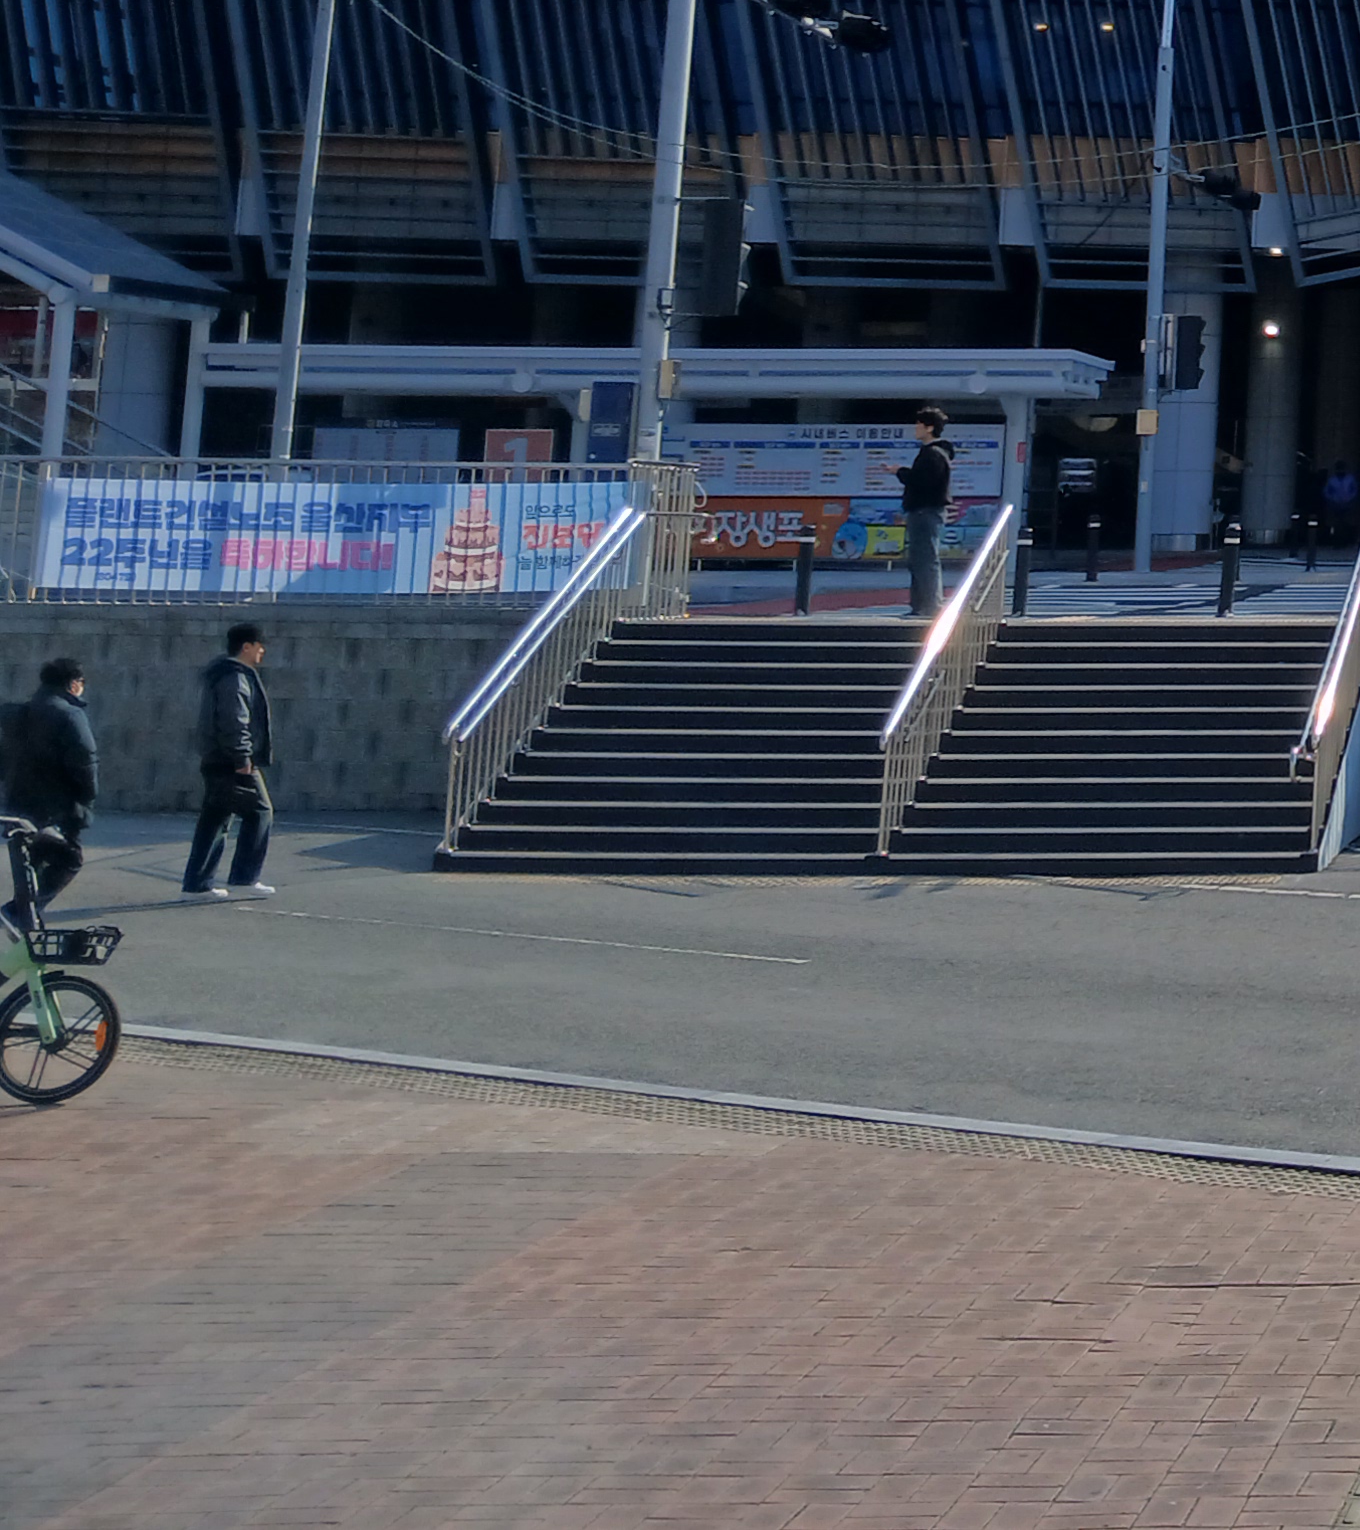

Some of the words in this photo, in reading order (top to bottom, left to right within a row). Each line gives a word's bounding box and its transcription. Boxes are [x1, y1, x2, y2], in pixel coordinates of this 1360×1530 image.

[801, 427, 849, 440] 시내버스
[856, 427, 904, 440] 이용안내
[524, 504, 577, 520] 앞으로도
[61, 537, 213, 570] 22주년을
